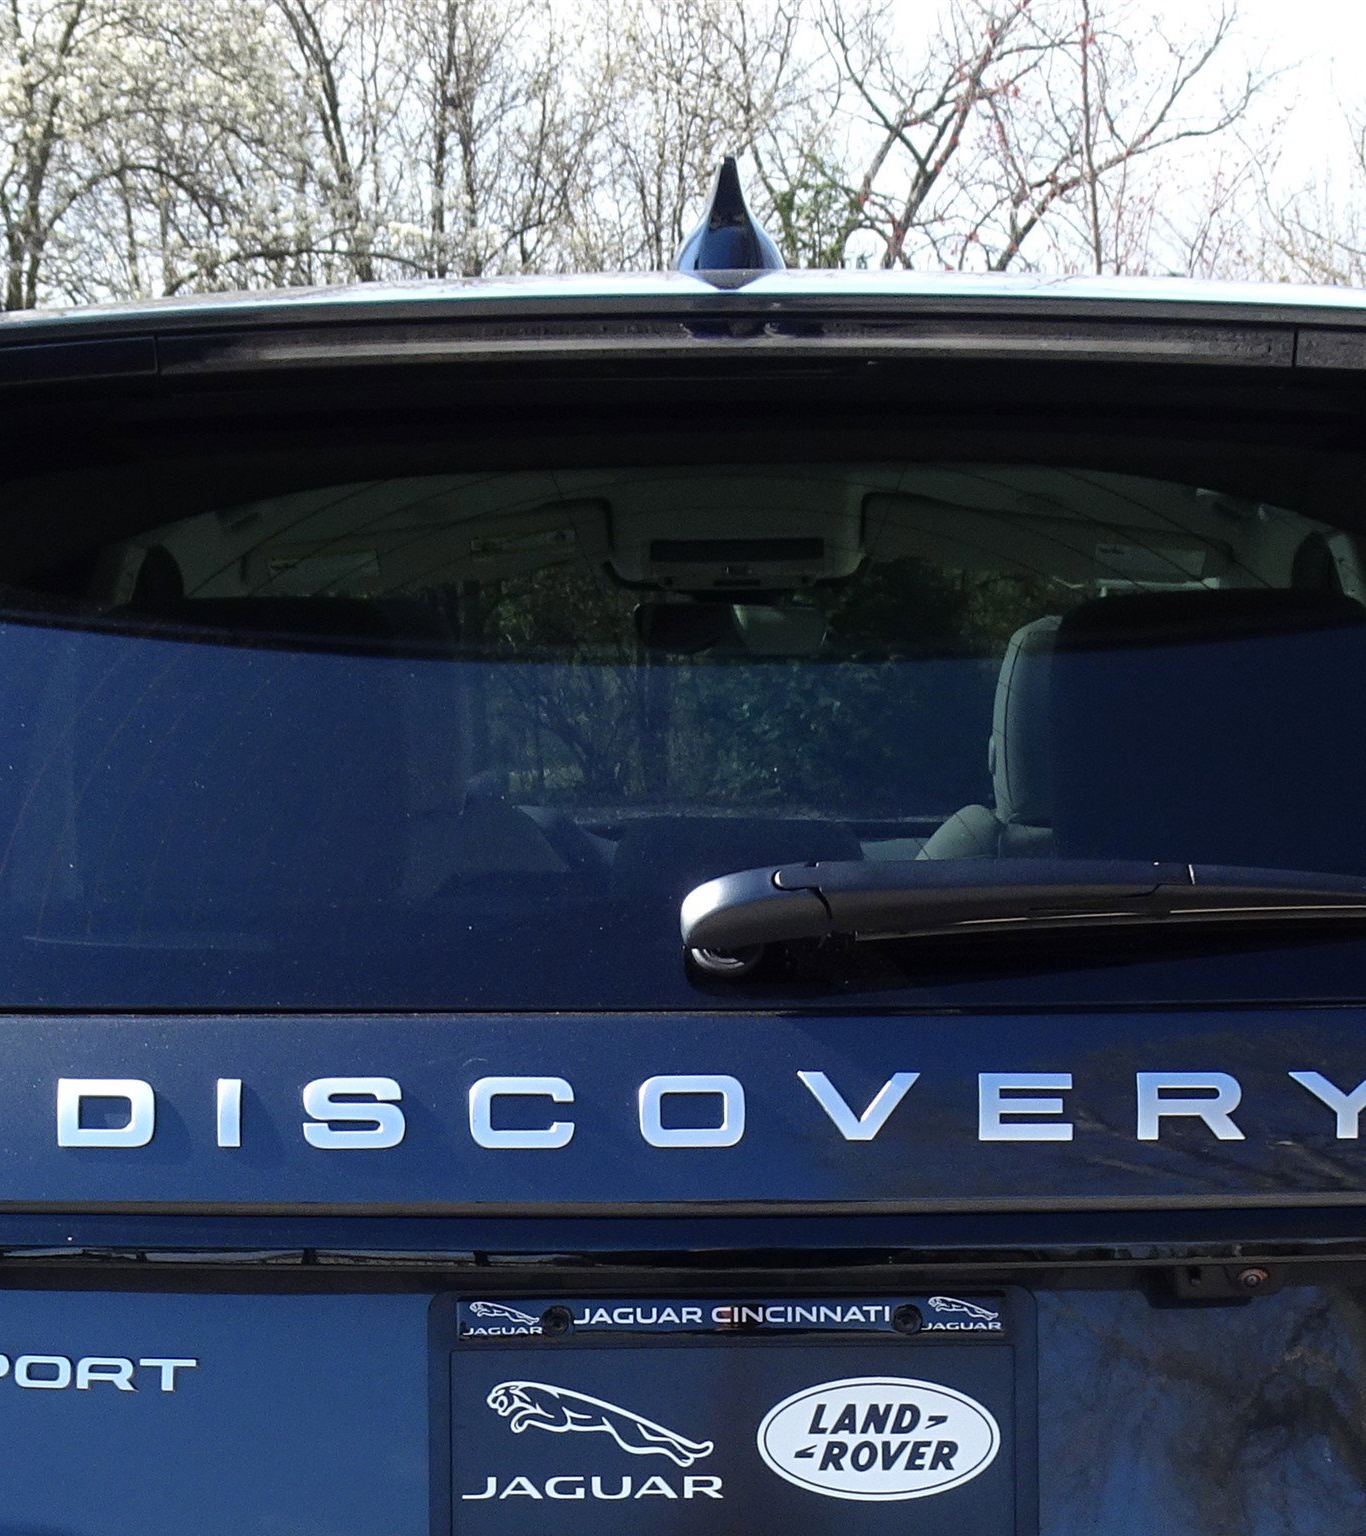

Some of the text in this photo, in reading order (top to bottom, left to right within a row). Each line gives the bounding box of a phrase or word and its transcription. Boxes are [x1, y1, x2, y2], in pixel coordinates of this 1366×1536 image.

[573, 1305, 890, 1325] JAGUAR CINCINNATI
[463, 1326, 543, 1336] JAGUAR
[921, 1321, 1002, 1331] JAGUAR
[461, 1475, 724, 1500] JAGUAR
